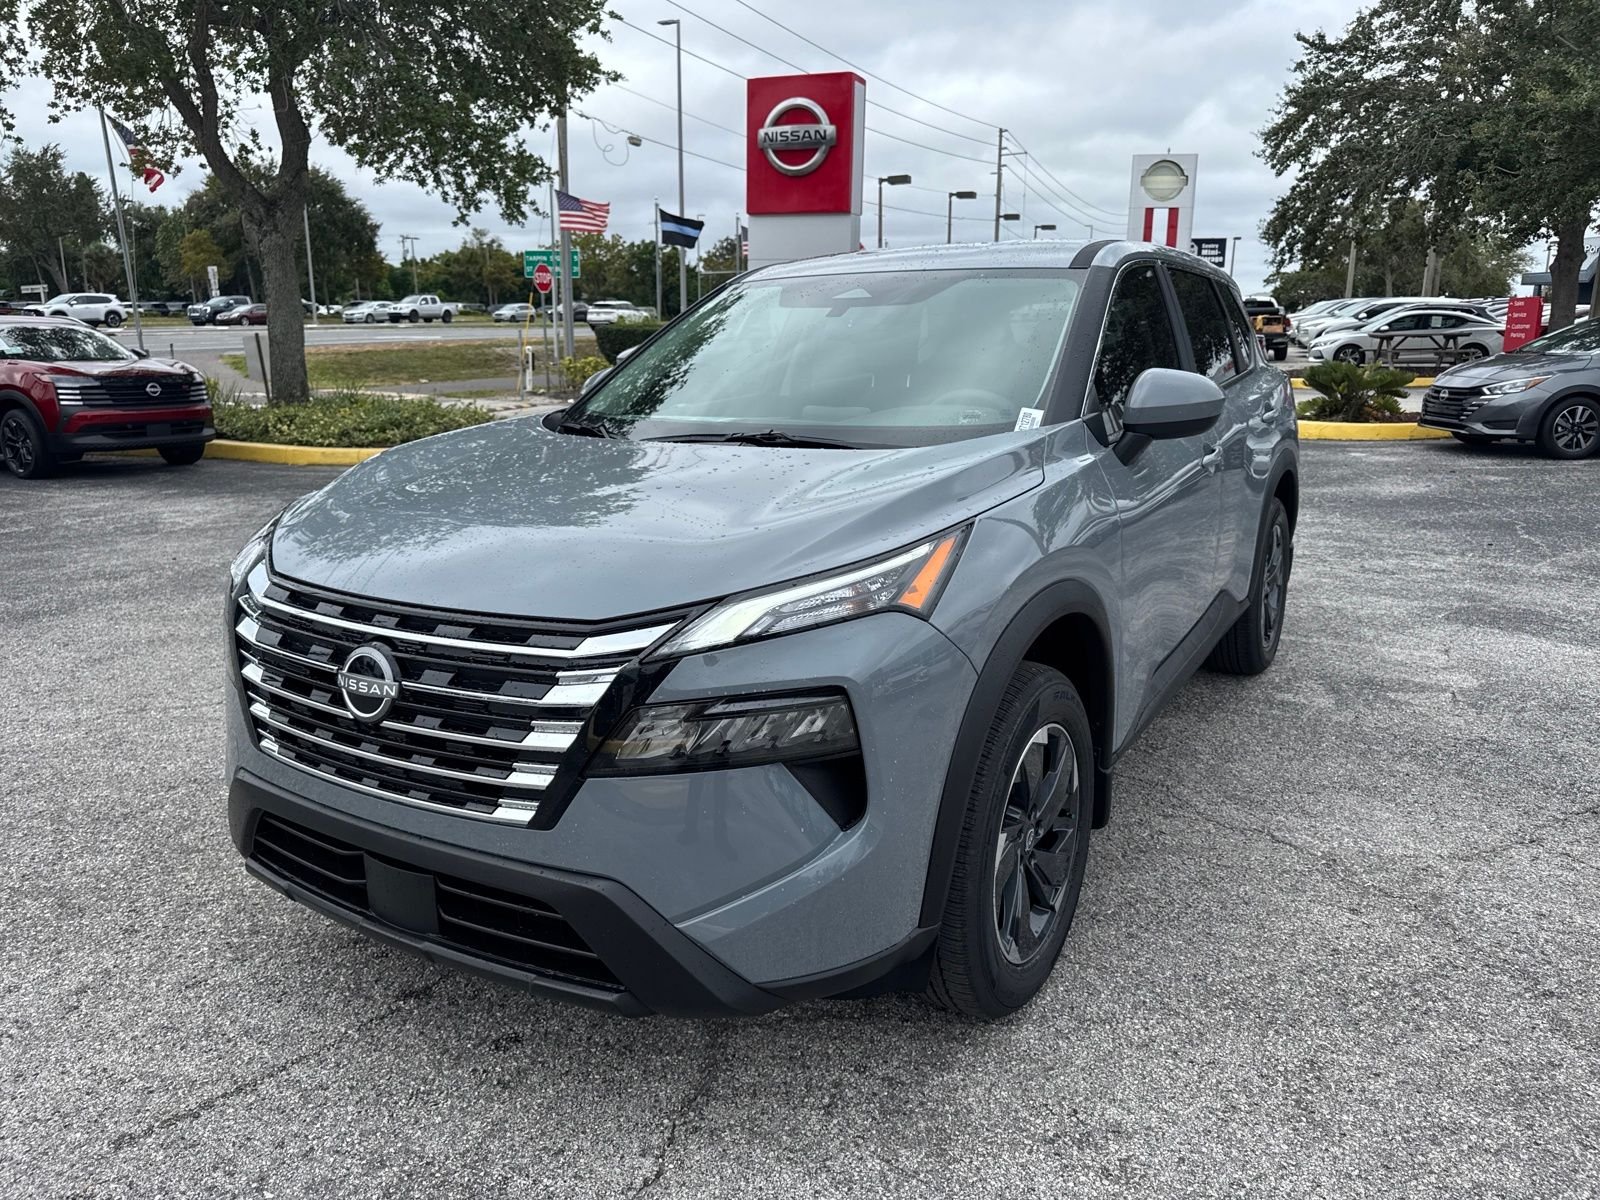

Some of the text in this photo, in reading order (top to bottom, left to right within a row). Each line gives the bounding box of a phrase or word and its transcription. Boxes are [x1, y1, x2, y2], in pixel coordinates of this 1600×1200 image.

[763, 129, 827, 143] NISSAN
[535, 272, 551, 284] STOP
[337, 673, 396, 696] NISSAN
